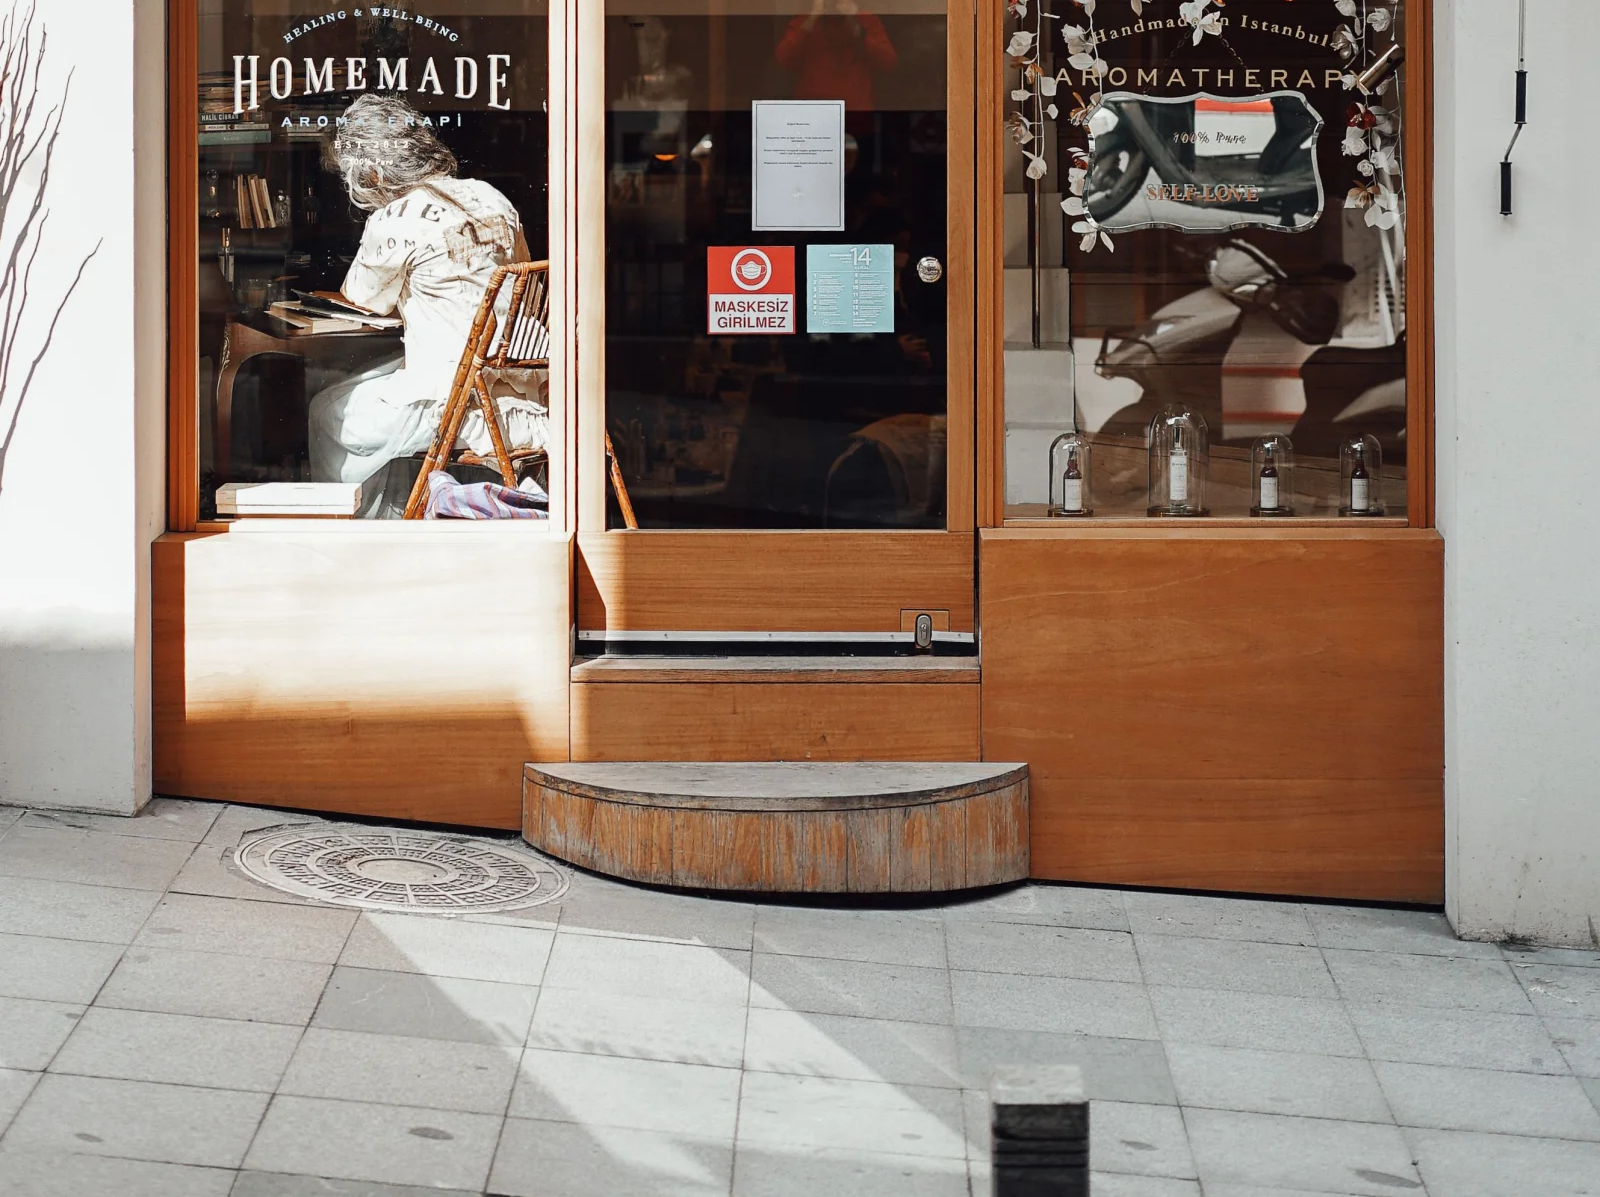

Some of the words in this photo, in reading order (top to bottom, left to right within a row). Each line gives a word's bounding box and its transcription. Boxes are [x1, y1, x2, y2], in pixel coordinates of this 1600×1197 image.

[282, 10, 347, 44] HEALING
[353, 8, 363, 18] &
[370, 7, 459, 43] WELL-BEING
[1240, 14, 1329, 48] Istanbul
[232, 54, 511, 115] HOMEMADE
[1173, 131, 1209, 144] 100%
[1215, 131, 1247, 144] Pure
[1146, 184, 1259, 202] SELF-LOVE
[850, 247, 872, 266] 14
[714, 298, 789, 313] MASKESİZ
[717, 313, 786, 329] GİRİLMEZ
